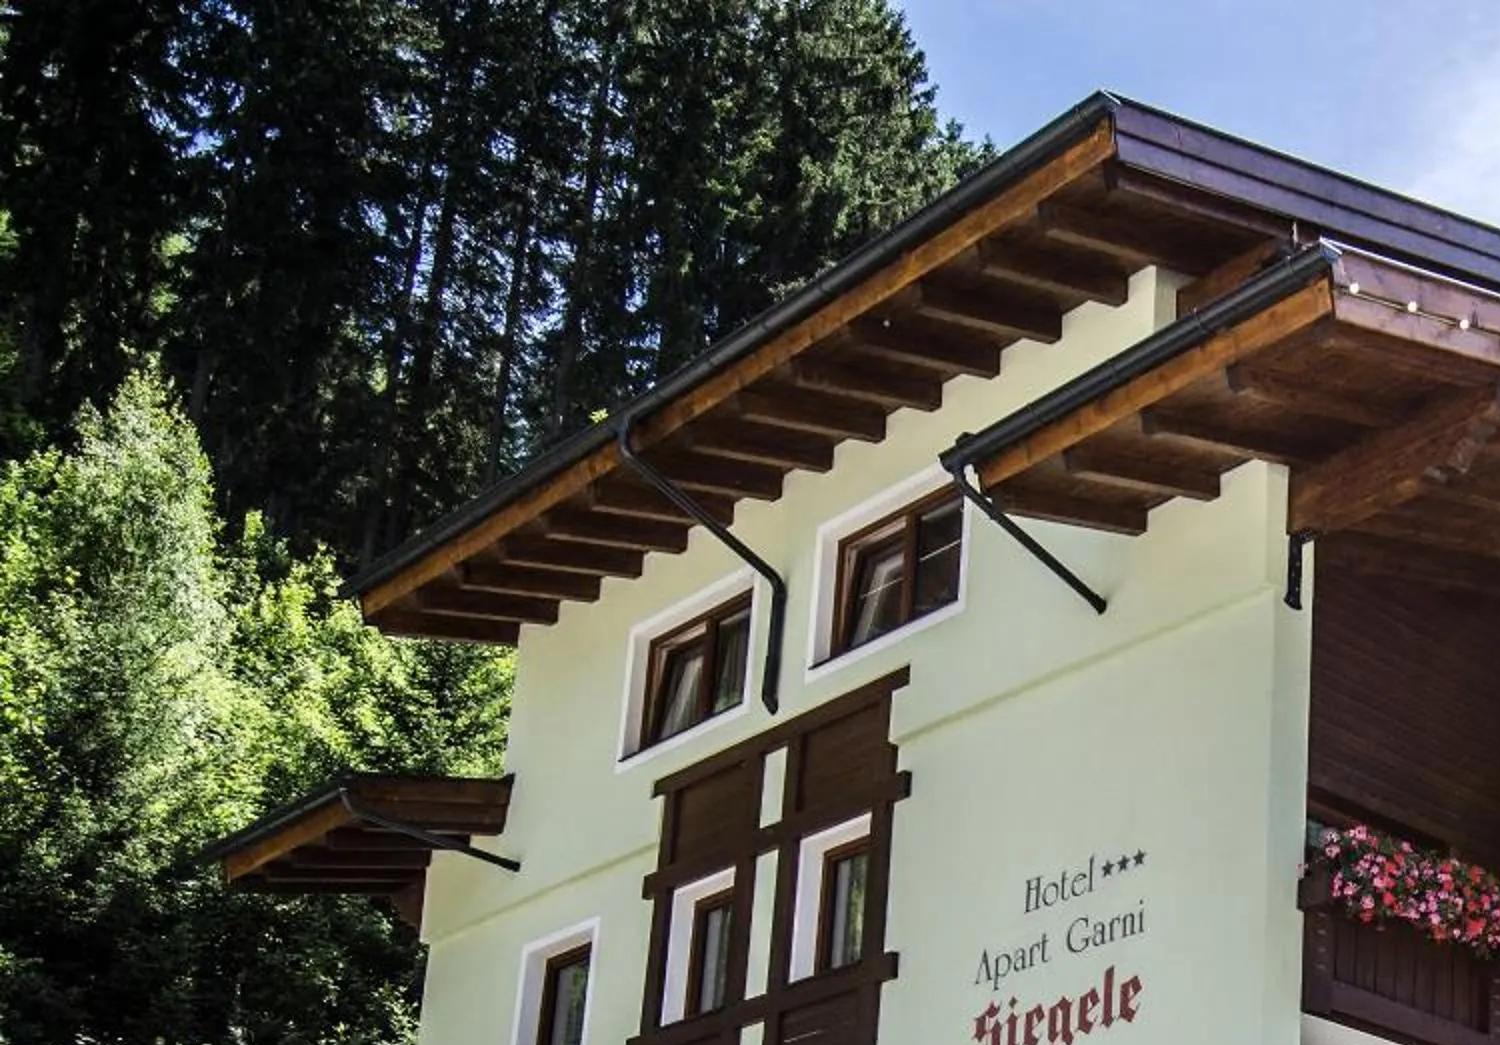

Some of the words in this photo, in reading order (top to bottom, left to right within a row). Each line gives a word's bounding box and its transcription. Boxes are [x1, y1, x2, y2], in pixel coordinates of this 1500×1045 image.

[1024, 854, 1096, 914] Hotel
[974, 932, 1051, 991] Apart
[1064, 898, 1146, 954] Garni
